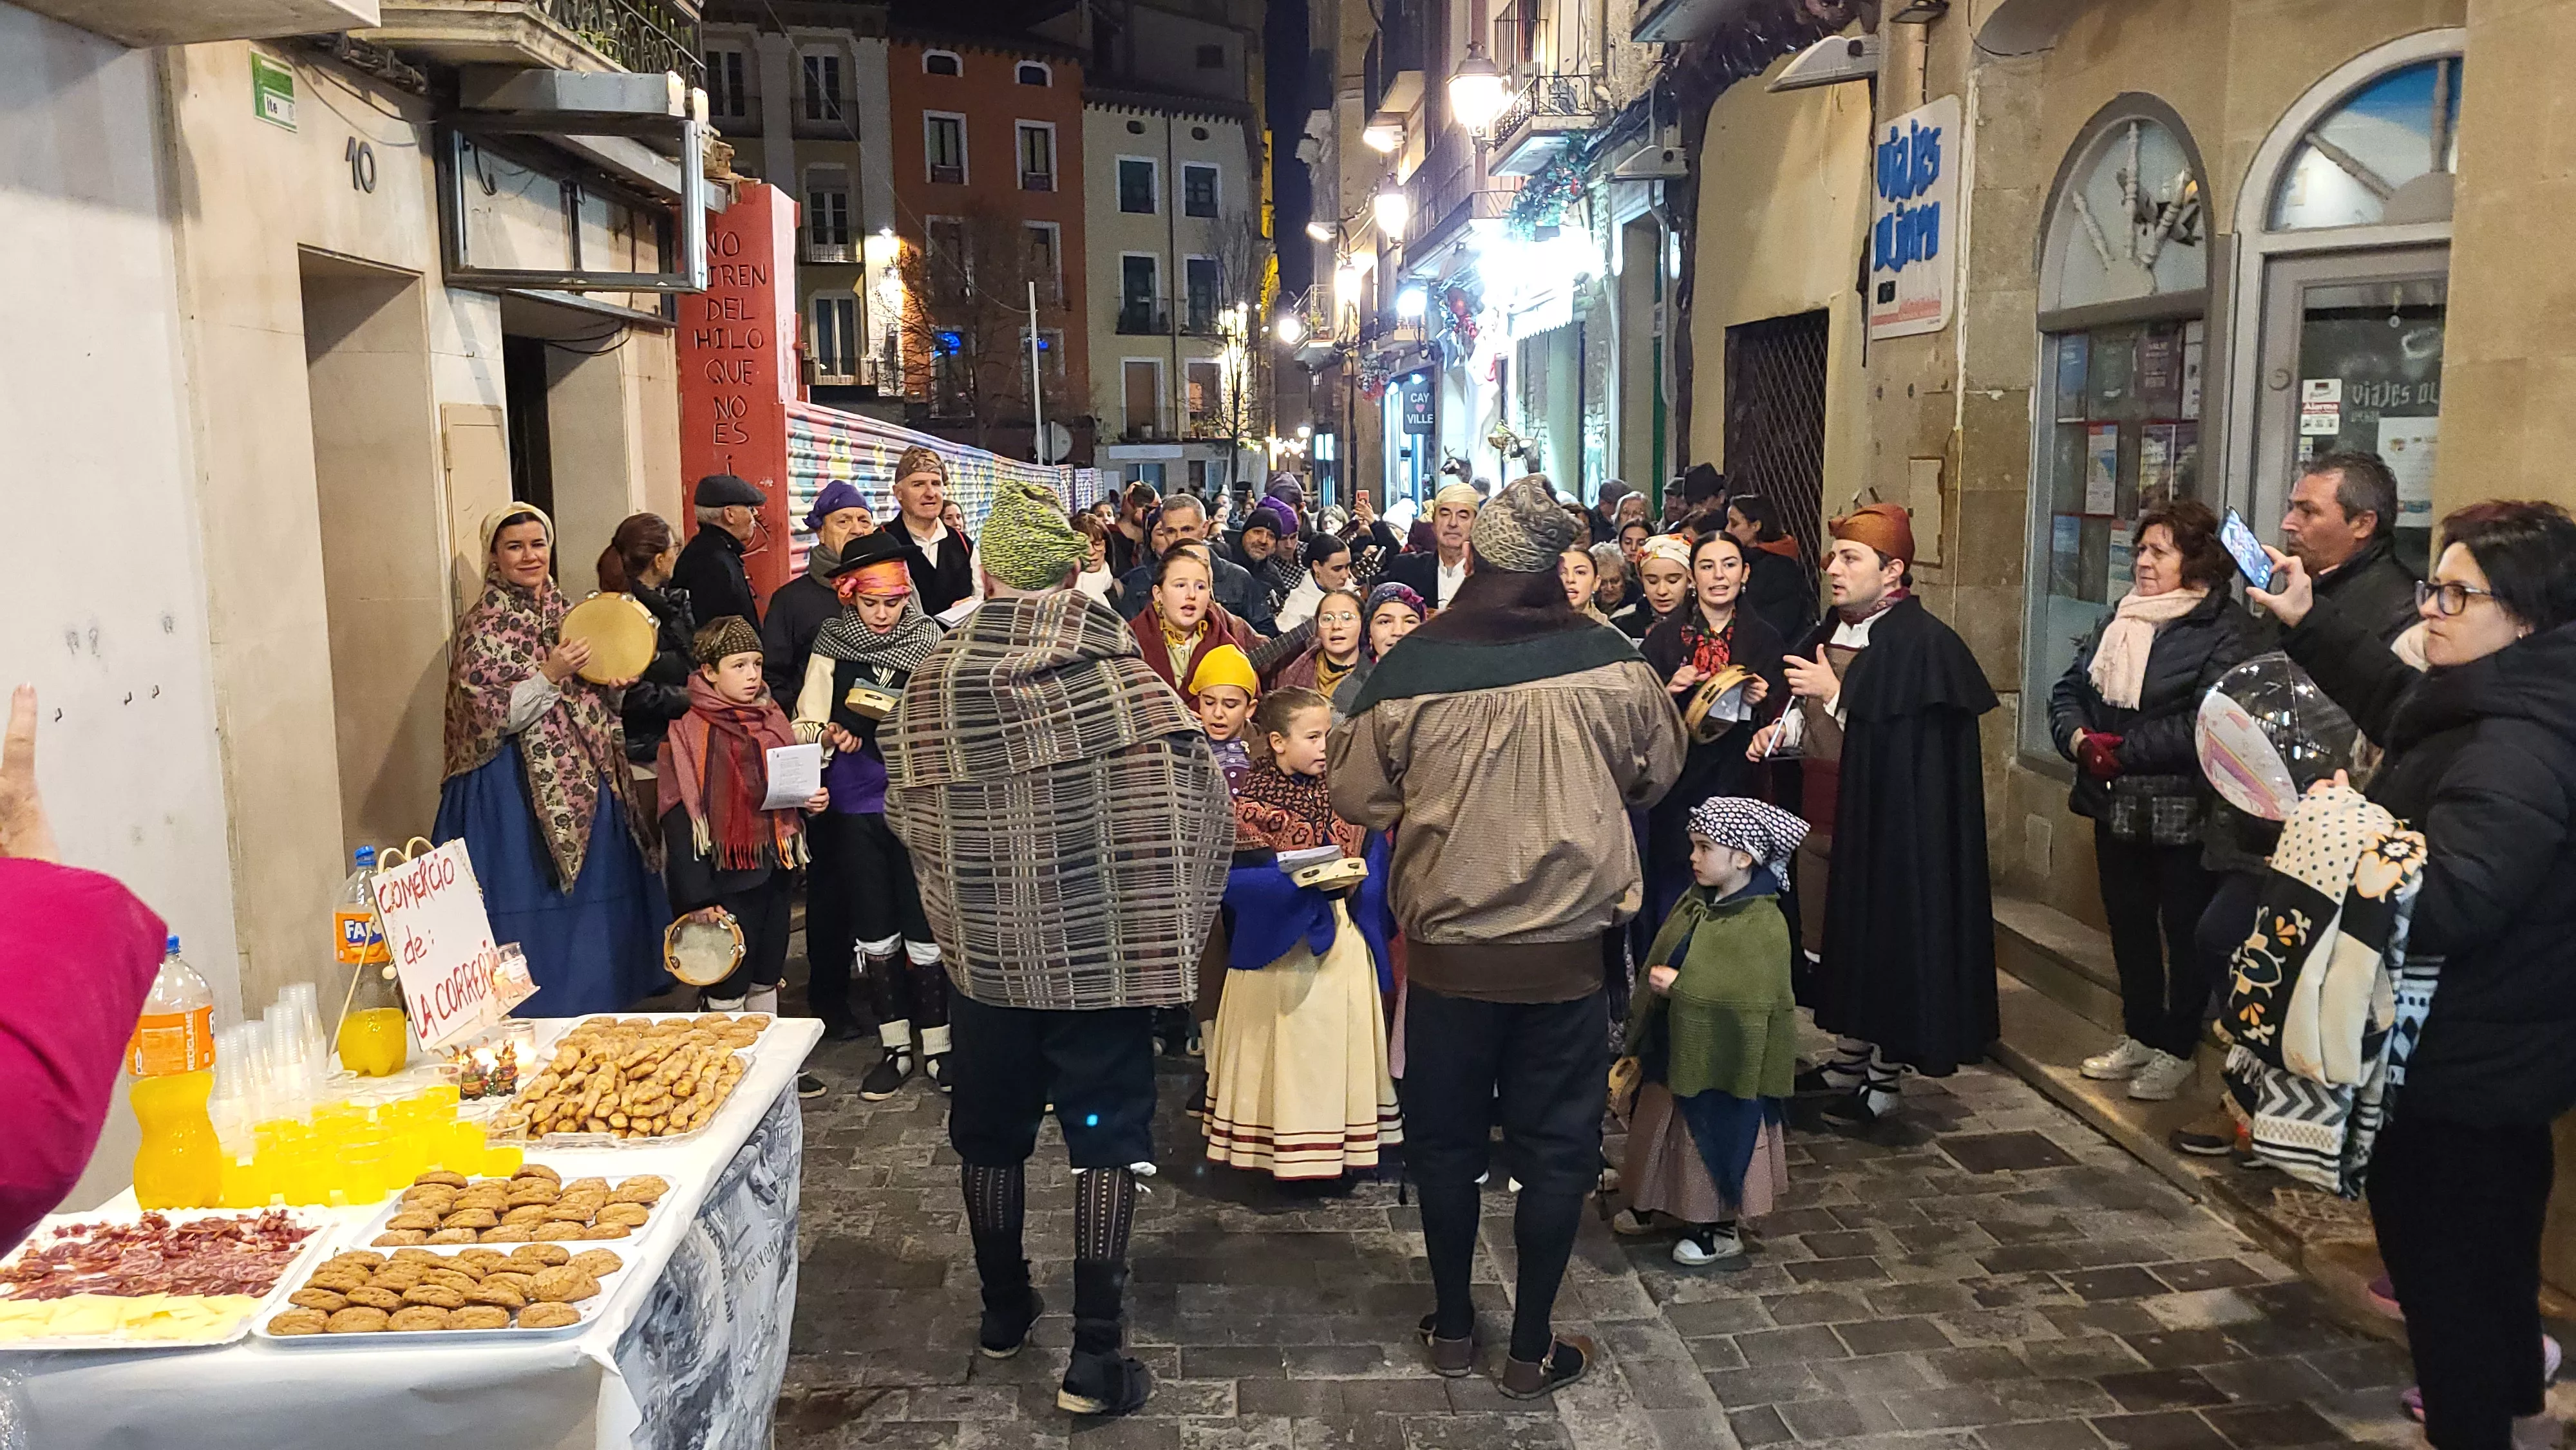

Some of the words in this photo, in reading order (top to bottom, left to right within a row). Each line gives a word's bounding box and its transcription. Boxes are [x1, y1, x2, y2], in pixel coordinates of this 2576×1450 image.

[345, 136, 377, 194] 10
[706, 263, 767, 288] IREN
[706, 297, 755, 321] DEL
[694, 327, 764, 350] HILO
[705, 359, 754, 386] QUE
[714, 395, 748, 420] NO
[1410, 392, 1430, 404] CAY
[1406, 413, 1434, 424] VILLE
[714, 422, 750, 445] ES
[408, 993, 440, 1039] LA
